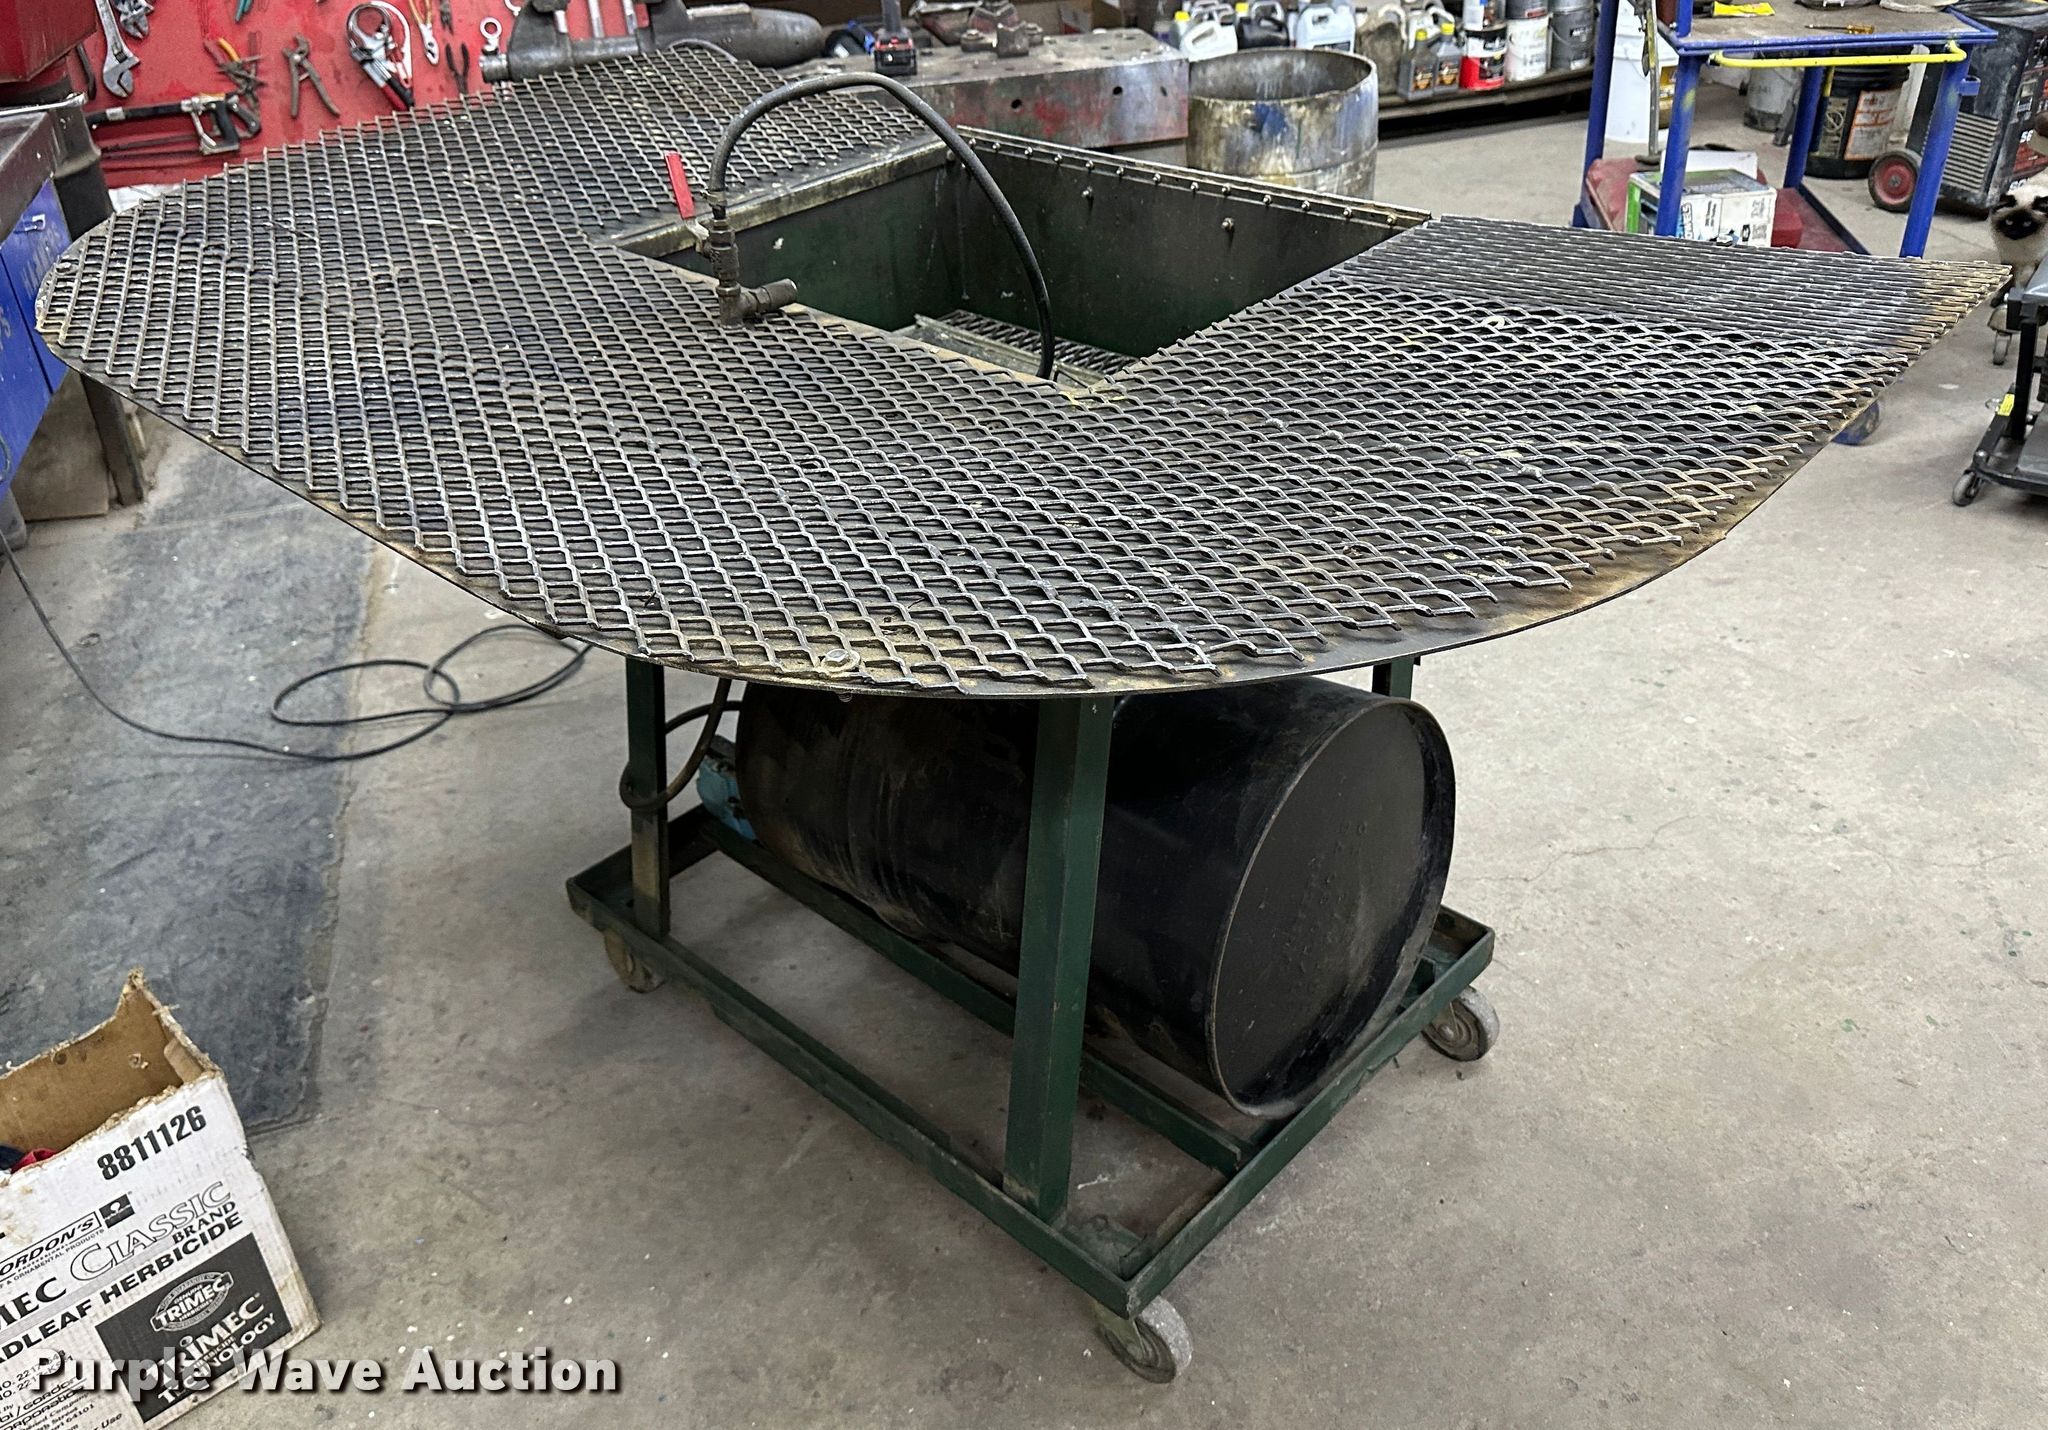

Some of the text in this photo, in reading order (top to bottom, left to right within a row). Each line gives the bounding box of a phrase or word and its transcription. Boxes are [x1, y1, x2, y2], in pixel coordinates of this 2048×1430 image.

[97, 1105, 207, 1181] 8811126
[0, 1218, 94, 1276] ORDON'S
[172, 1201, 236, 1244] BRAND
[13, 1252, 64, 1281] ORNAMENTAL
[65, 1229, 105, 1253] PRODUCTS
[0, 1299, 92, 1363] DLEAF
[100, 1212, 243, 1304] HERBICIDE
[155, 1278, 226, 1327] TRIMEC
[66, 1403, 95, 1422] 64101
